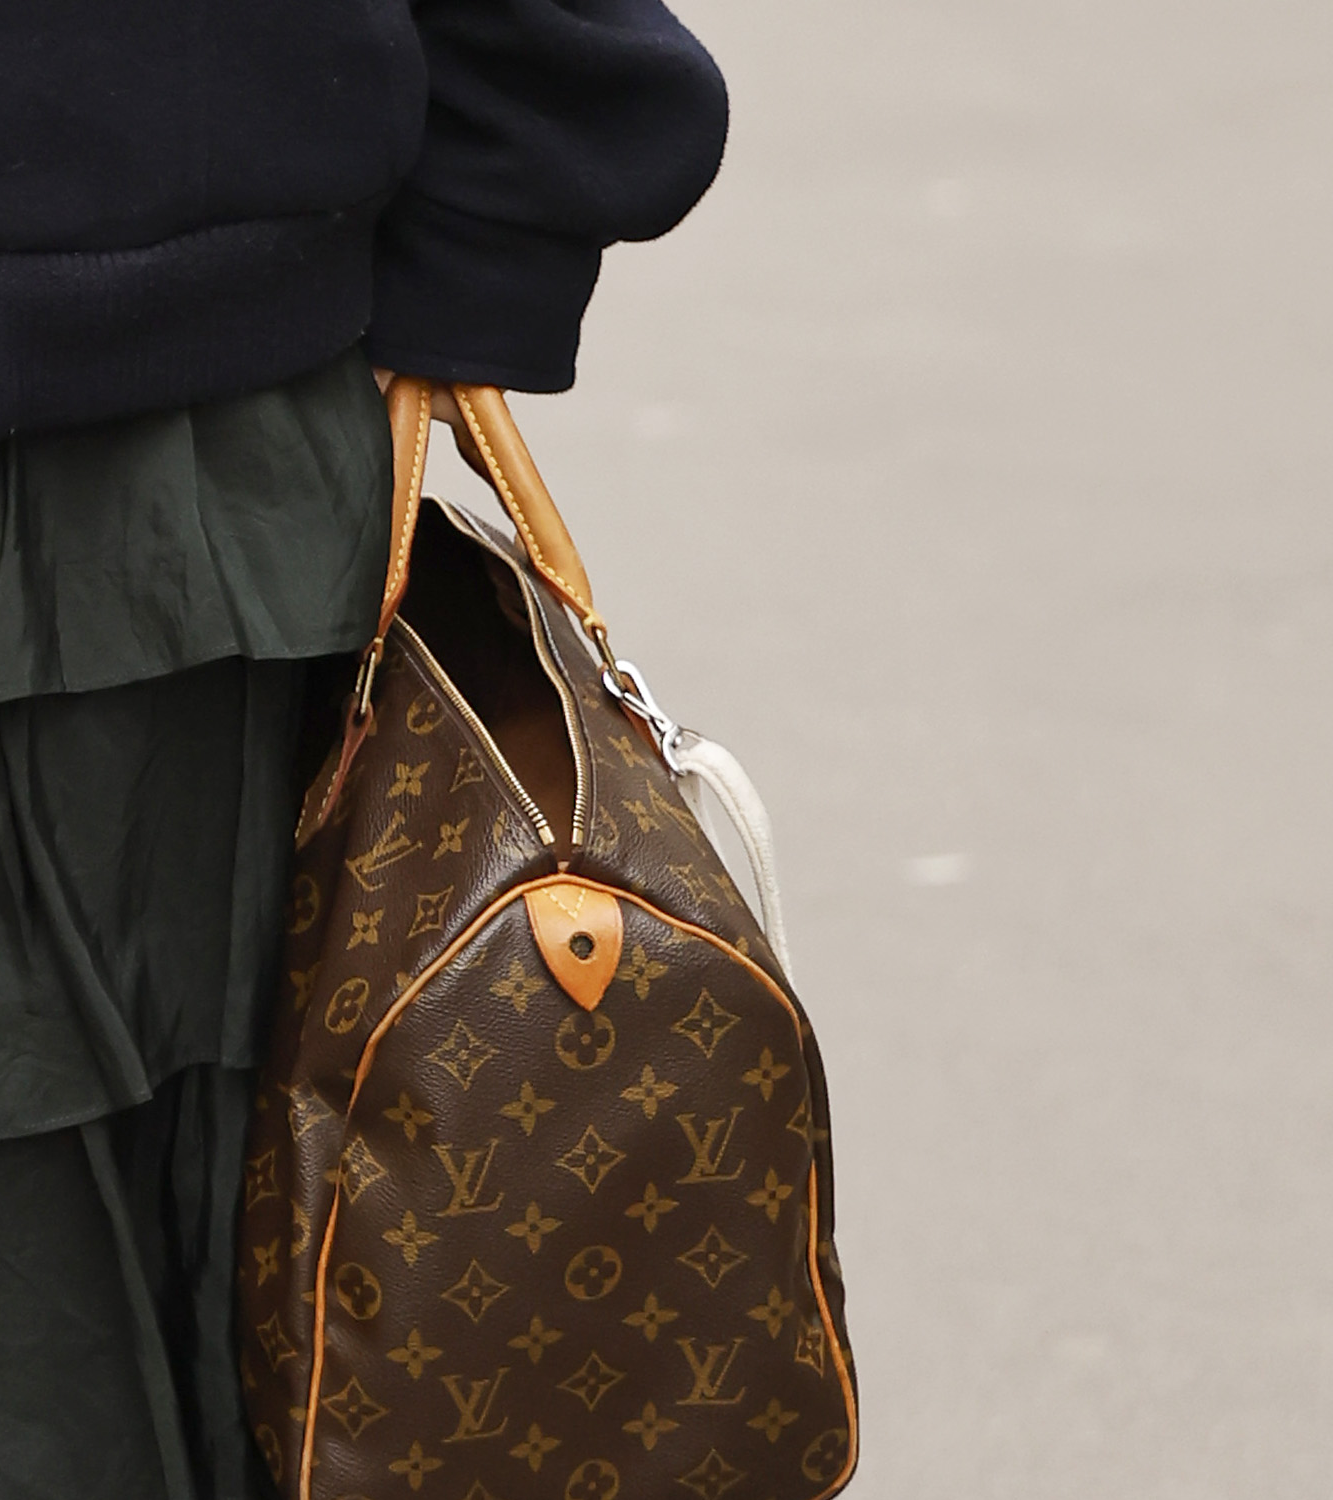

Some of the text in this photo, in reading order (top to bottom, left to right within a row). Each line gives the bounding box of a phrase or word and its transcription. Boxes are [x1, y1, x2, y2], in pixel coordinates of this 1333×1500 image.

[431, 1137, 506, 1218] LV
[676, 1106, 746, 1185] LV
[440, 1366, 512, 1443] LV
[676, 1336, 748, 1406] LV
